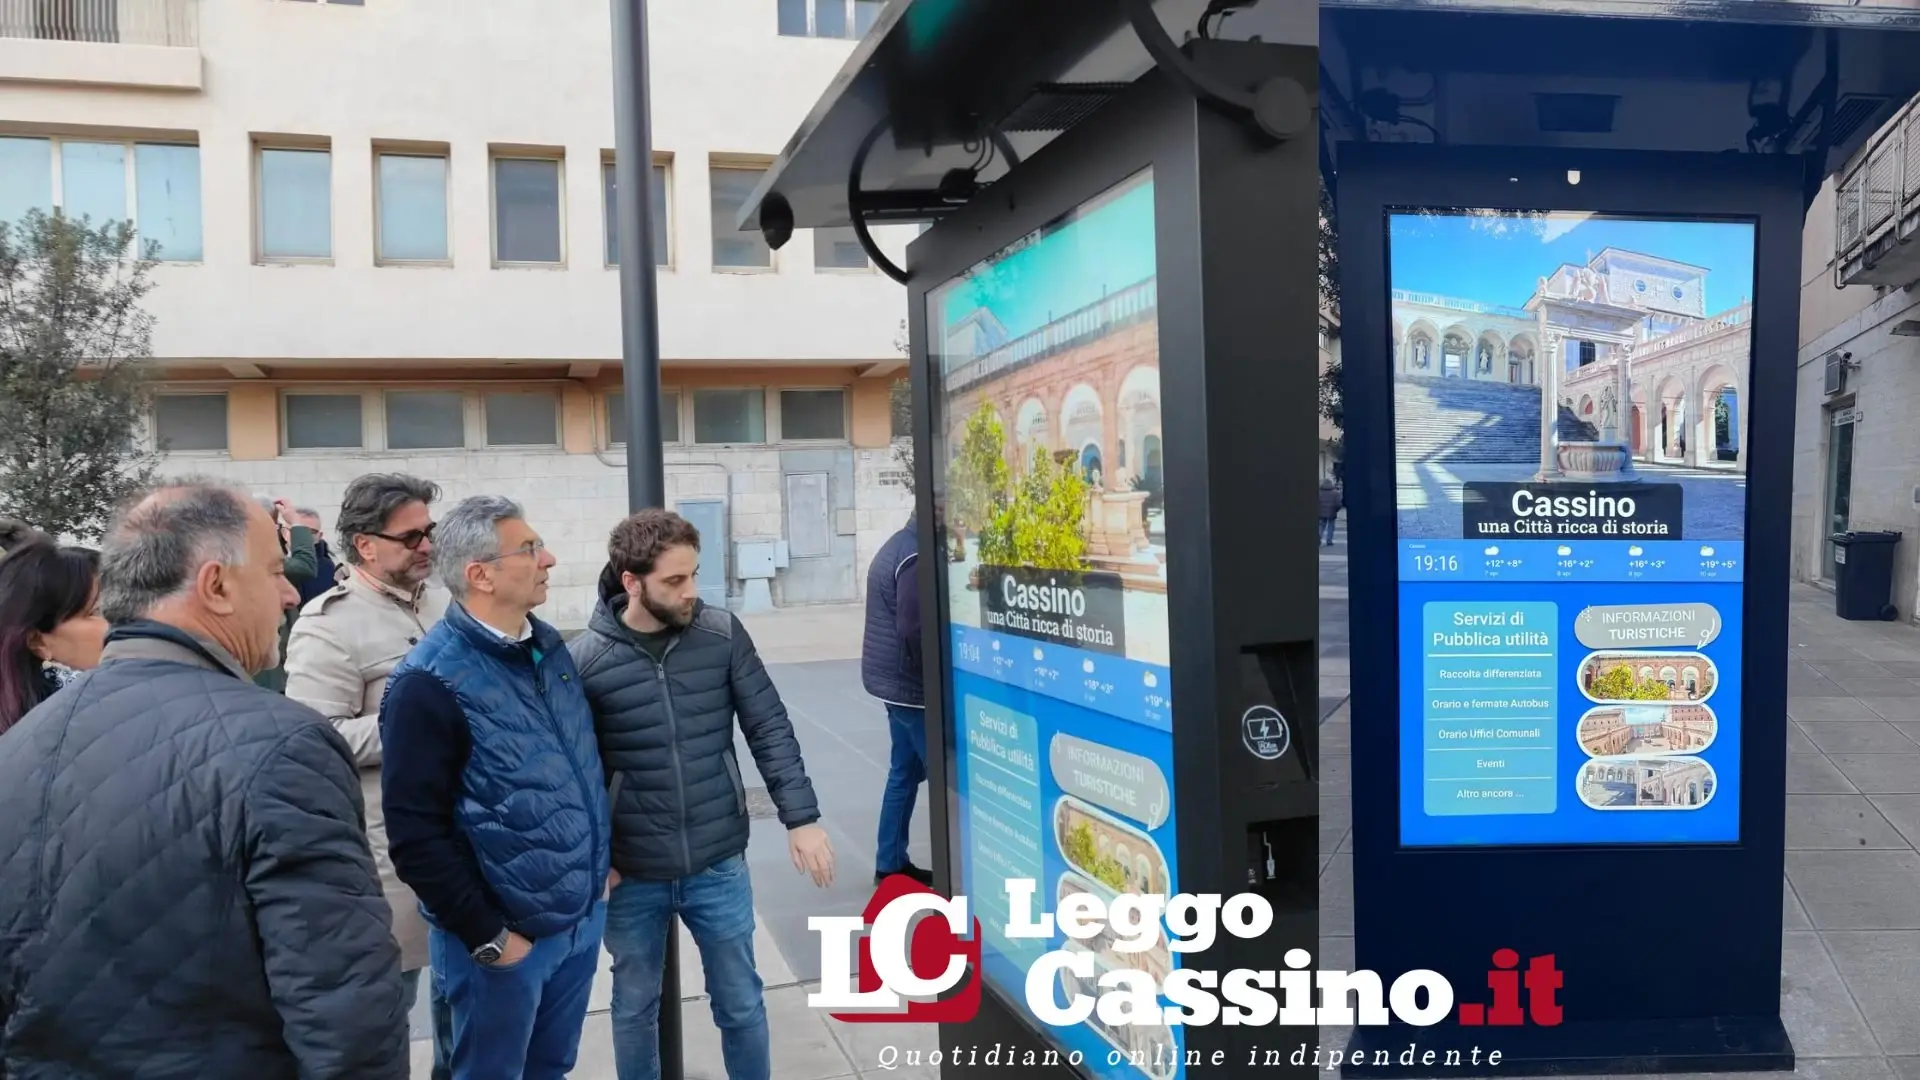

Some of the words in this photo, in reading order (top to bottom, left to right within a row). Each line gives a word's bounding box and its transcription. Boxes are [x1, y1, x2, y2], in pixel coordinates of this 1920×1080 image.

[1512, 490, 1636, 518] Cassino
[1478, 522, 1510, 534] una
[1514, 519, 1552, 535] Città
[1557, 520, 1598, 535] ricca
[1602, 520, 1618, 535] di
[1622, 519, 1669, 535] storia
[1414, 555, 1458, 571] 19:16
[1003, 574, 1085, 617] Cassino
[1453, 611, 1504, 626] Servizi
[1510, 611, 1524, 626] di
[1602, 609, 1695, 624] INFORMAZIONI
[987, 610, 1005, 626] una
[1006, 611, 1030, 630] Città
[1032, 614, 1059, 636] ricca
[1062, 618, 1073, 638] di
[1076, 624, 1114, 646] storia
[1608, 627, 1686, 640] TURISTICHE
[1433, 632, 1500, 646] Pubblica
[1505, 631, 1549, 646] utilità
[1440, 669, 1481, 679] Raccolta
[1483, 668, 1541, 679] differenziata
[1432, 699, 1461, 709] Orario
[1463, 701, 1470, 709] e
[1472, 699, 1508, 709] fermate
[1510, 698, 1549, 708] Autobus
[1438, 729, 1468, 739] Orario
[1469, 729, 1494, 739] Uffici
[1496, 728, 1540, 738] Comunali
[1067, 745, 1144, 784] INFORMAZIONI
[1477, 759, 1505, 768] Eventi
[1073, 769, 1136, 807] TURISTICHE
[1457, 789, 1479, 798] Altro
[1482, 789, 1513, 798] ancora
